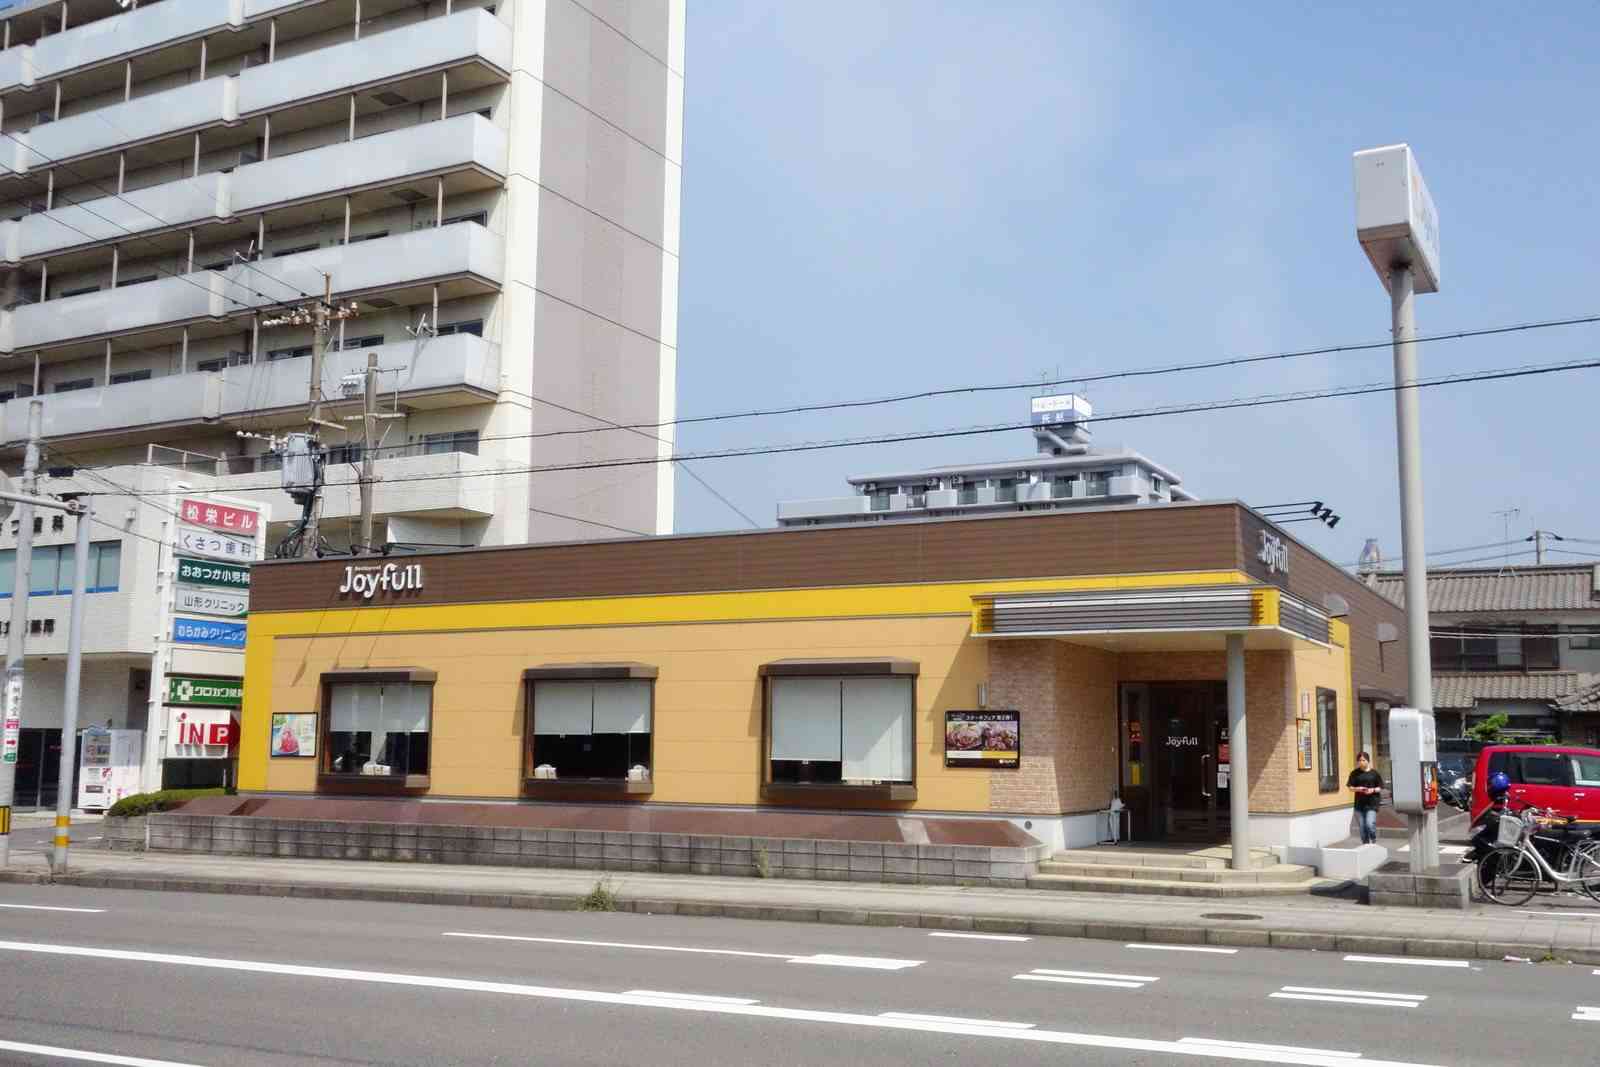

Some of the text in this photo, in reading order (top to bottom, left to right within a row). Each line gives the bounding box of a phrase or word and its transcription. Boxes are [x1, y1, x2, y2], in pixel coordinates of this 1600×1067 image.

[183, 534, 252, 556] くさつ歯科
[339, 562, 423, 598] Joyfull
[184, 594, 245, 612] 山形クリニック
[1165, 735, 1198, 748] Joyfull
